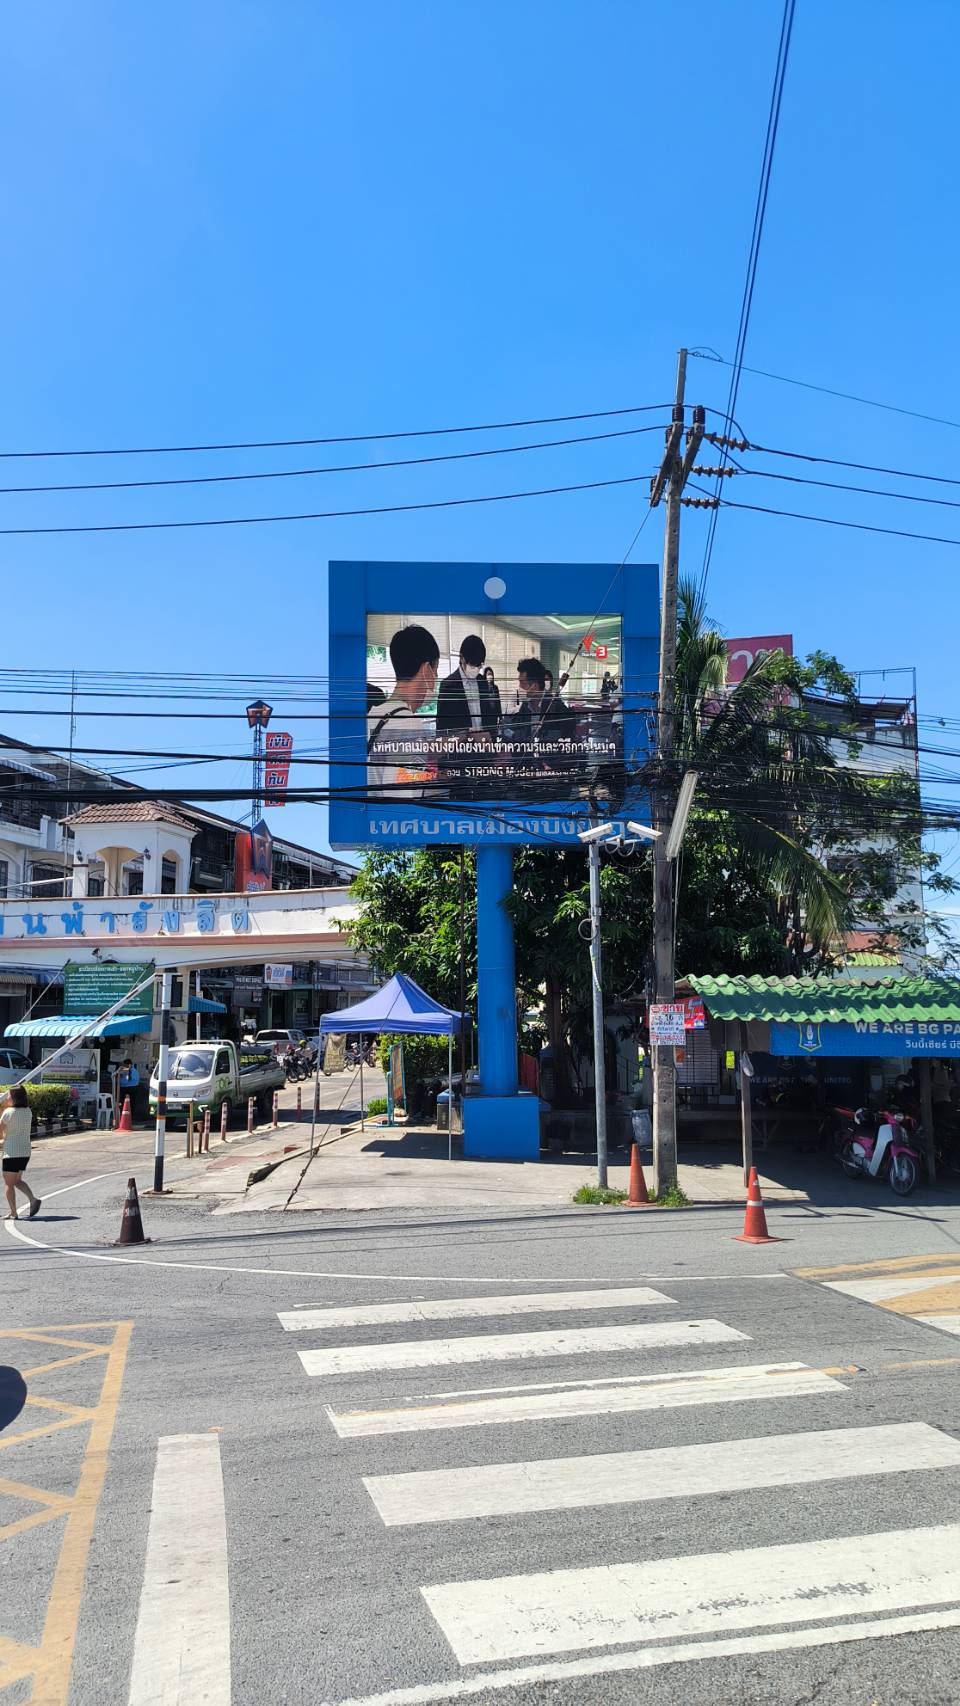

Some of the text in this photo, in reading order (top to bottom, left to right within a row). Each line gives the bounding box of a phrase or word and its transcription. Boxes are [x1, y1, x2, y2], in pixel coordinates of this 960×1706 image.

[597, 646, 605, 656] 3
[269, 735, 290, 747] เงิน
[464, 767, 503, 777] STRONG
[854, 1022, 878, 1033] WE
[882, 1023, 914, 1034] ARE
[918, 1024, 939, 1035] BG
